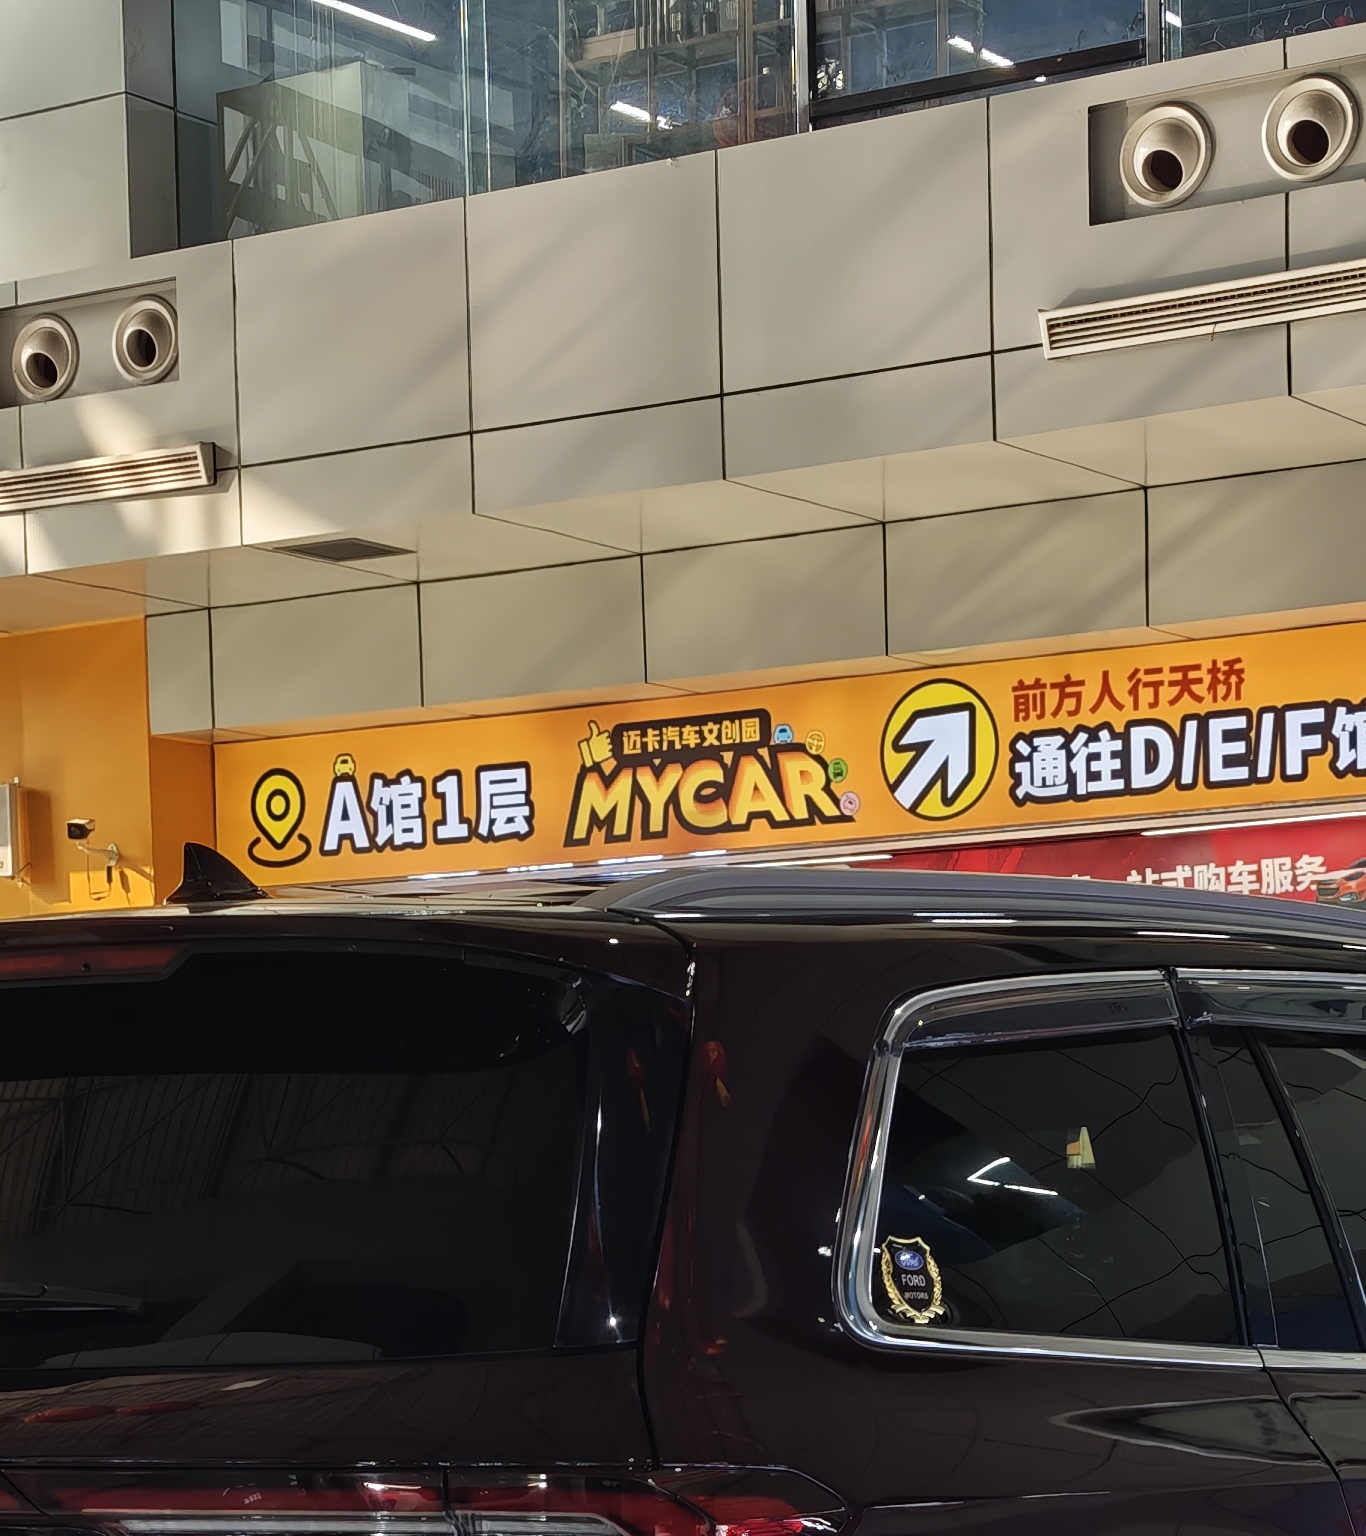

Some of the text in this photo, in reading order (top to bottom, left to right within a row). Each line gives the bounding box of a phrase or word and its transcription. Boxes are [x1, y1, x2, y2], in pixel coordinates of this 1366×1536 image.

[1011, 658, 1246, 722] 前方人行天桥
[621, 716, 761, 755] 迈卡汽车文创园
[322, 761, 532, 851] A馆1层
[572, 751, 838, 841] MYCAR
[900, 1273, 926, 1287] FORD
